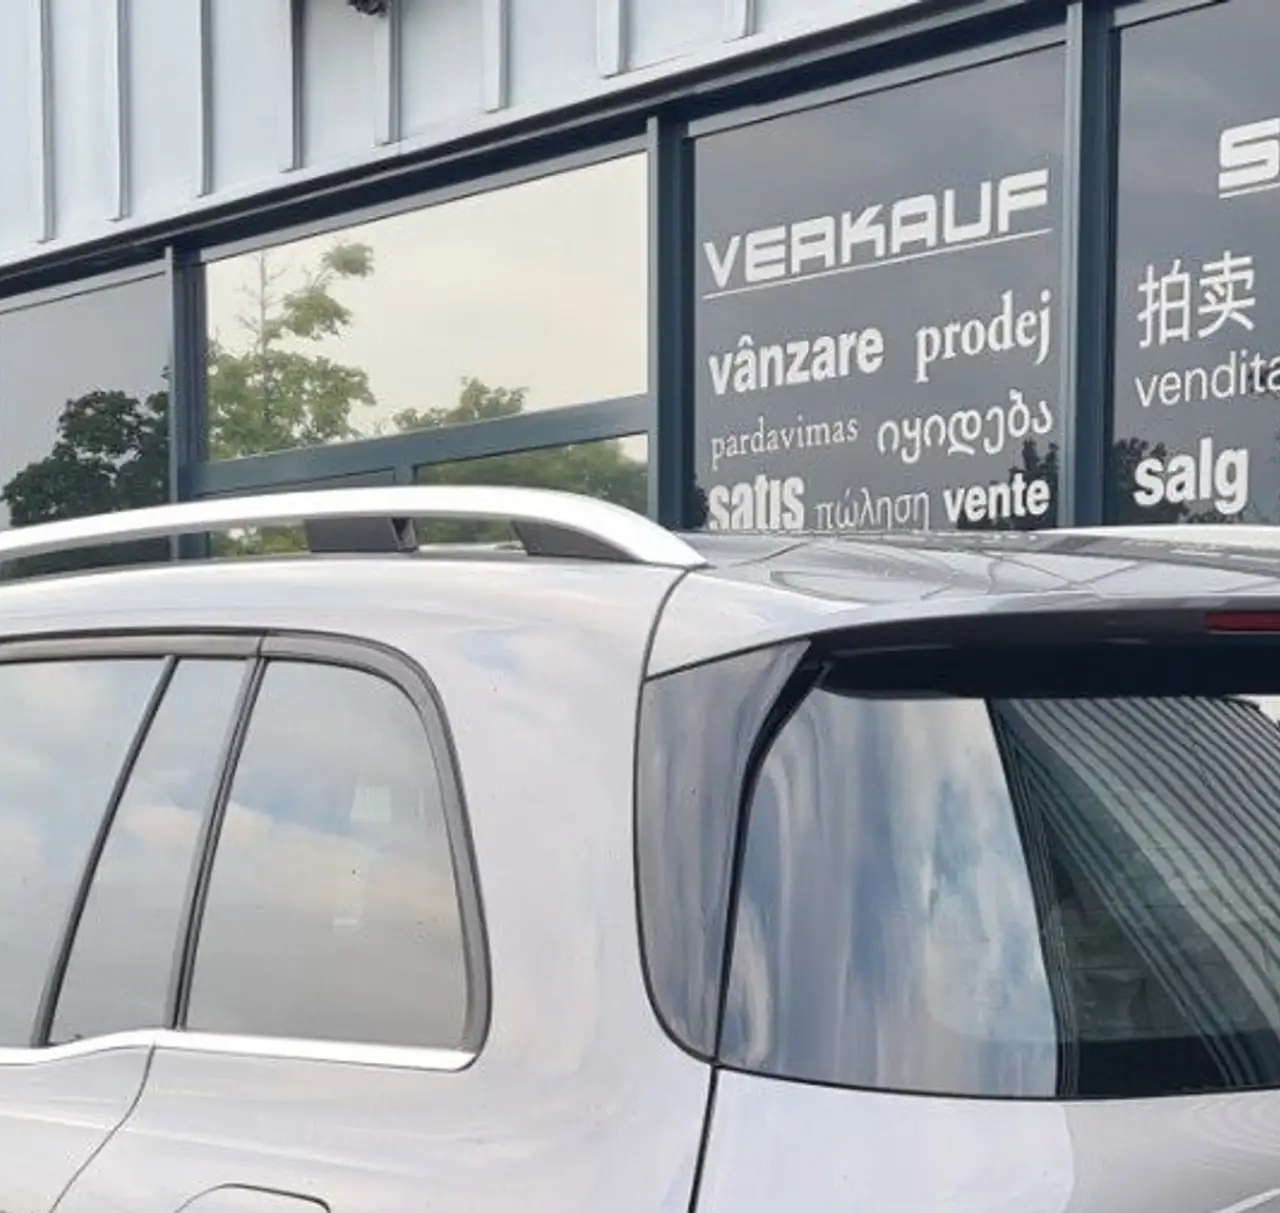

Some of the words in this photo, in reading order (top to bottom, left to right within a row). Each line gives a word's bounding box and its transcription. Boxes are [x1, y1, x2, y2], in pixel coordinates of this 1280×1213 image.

[703, 168, 1050, 289] VERKAUF
[1135, 248, 1257, 348] 拍卖
[707, 326, 885, 397] vânzare
[915, 289, 1052, 383] prodej
[710, 414, 860, 472] pardavimas
[877, 388, 1054, 465] იყიდება
[942, 472, 1052, 525] vente
[1133, 437, 1250, 515] salg
